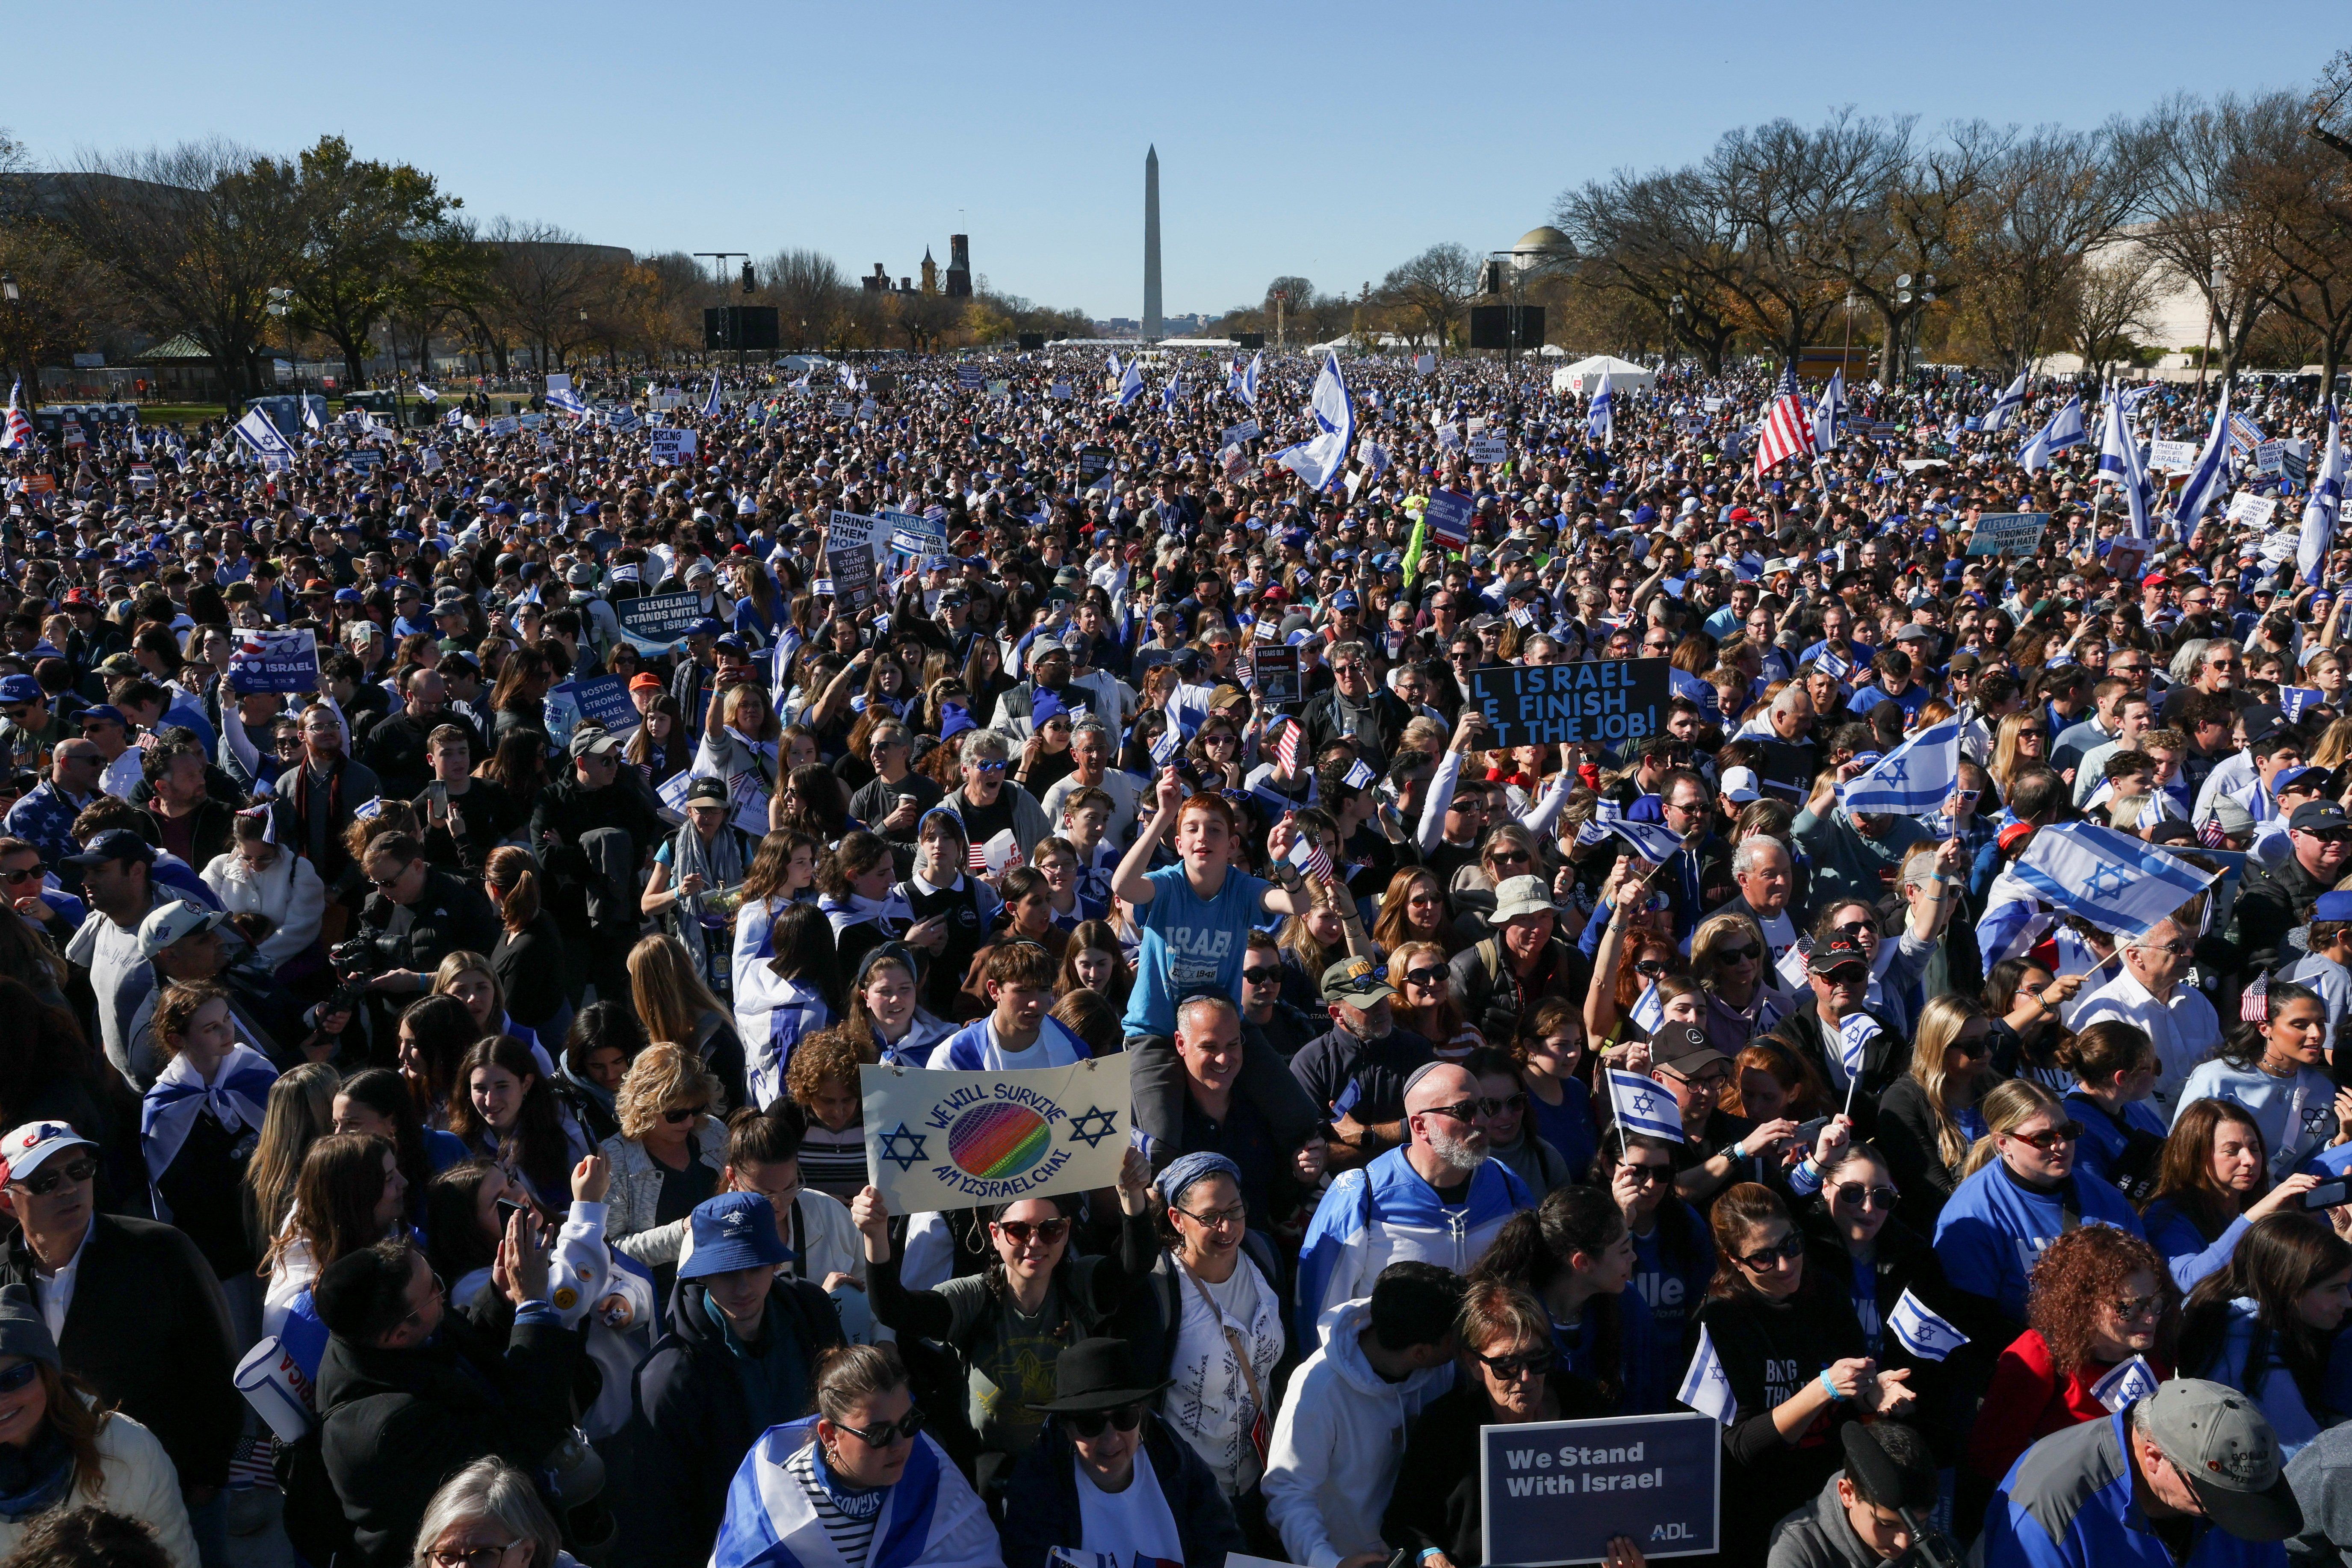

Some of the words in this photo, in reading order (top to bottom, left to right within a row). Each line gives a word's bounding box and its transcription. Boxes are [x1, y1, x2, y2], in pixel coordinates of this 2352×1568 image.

[1238, 425, 1253, 434] STANDS
[2238, 416, 2251, 428] BRING
[2249, 426, 2261, 438] HOME
[653, 431, 681, 442] BRING
[1439, 434, 1458, 442] SUPPORT
[654, 443, 678, 452] THEM
[1365, 445, 1373, 461] HOSTAGES
[2259, 441, 2287, 452] PHILLY
[1224, 449, 1235, 459] FREE
[1224, 452, 1238, 464] HOSTAGES
[1367, 444, 1378, 467] SUPPORT
[2288, 455, 2307, 466] CLEVELAND
[1223, 454, 1244, 469] SUPPORT
[2284, 459, 2296, 469] STANDS
[1230, 463, 1248, 476] COMBAT
[1428, 504, 1448, 514] AGAINST
[1430, 498, 1455, 511] AMERICANS
[834, 515, 874, 531] BRING
[1427, 509, 1459, 523] ANTISEMITISM
[891, 514, 936, 534] CLEVELAND
[1982, 515, 2037, 532] CLEVELAND
[832, 525, 867, 541] THEM
[1995, 527, 2037, 539] STRONGER
[1993, 538, 2015, 548] THAN
[2017, 536, 2037, 545] HATE
[844, 550, 859, 558] WE
[928, 546, 944, 555] HATE
[839, 555, 866, 566] STAND
[843, 563, 865, 573] WITH
[841, 570, 870, 582] ISRAEL
[638, 595, 698, 612] CLEVELAND
[625, 609, 669, 625] STANDS
[671, 605, 699, 621] WITH
[230, 662, 244, 671] DC
[266, 661, 313, 672] ISRAEL
[1514, 663, 1636, 694] ISRAEL
[582, 681, 619, 699] BOSTON
[585, 693, 626, 712] STRONG.
[1519, 689, 1626, 720] FINISH
[592, 706, 626, 720] ISRAEL
[1523, 718, 1581, 744] THE
[1590, 705, 1656, 740] JOB!
[697, 784, 720, 792] Coca-Cola
[1165, 927, 1232, 958] ISRAEL
[96, 943, 110, 960] Yalla,
[925, 1103, 956, 1129] WE
[950, 1084, 989, 1111] WILL
[994, 1083, 1068, 1125] SURVIVE
[932, 1165, 961, 1187] AM
[958, 1176, 1036, 1198] YISRAEL
[1031, 1149, 1072, 1183] CHAI
[1008, 1338, 1044, 1346] DEFENSE
[1506, 1448, 1551, 1470] We
[1559, 1442, 1644, 1466] Stand
[1506, 1474, 1575, 1497] With
[1582, 1468, 1663, 1493] Israel
[1649, 1523, 1694, 1541] ADL
